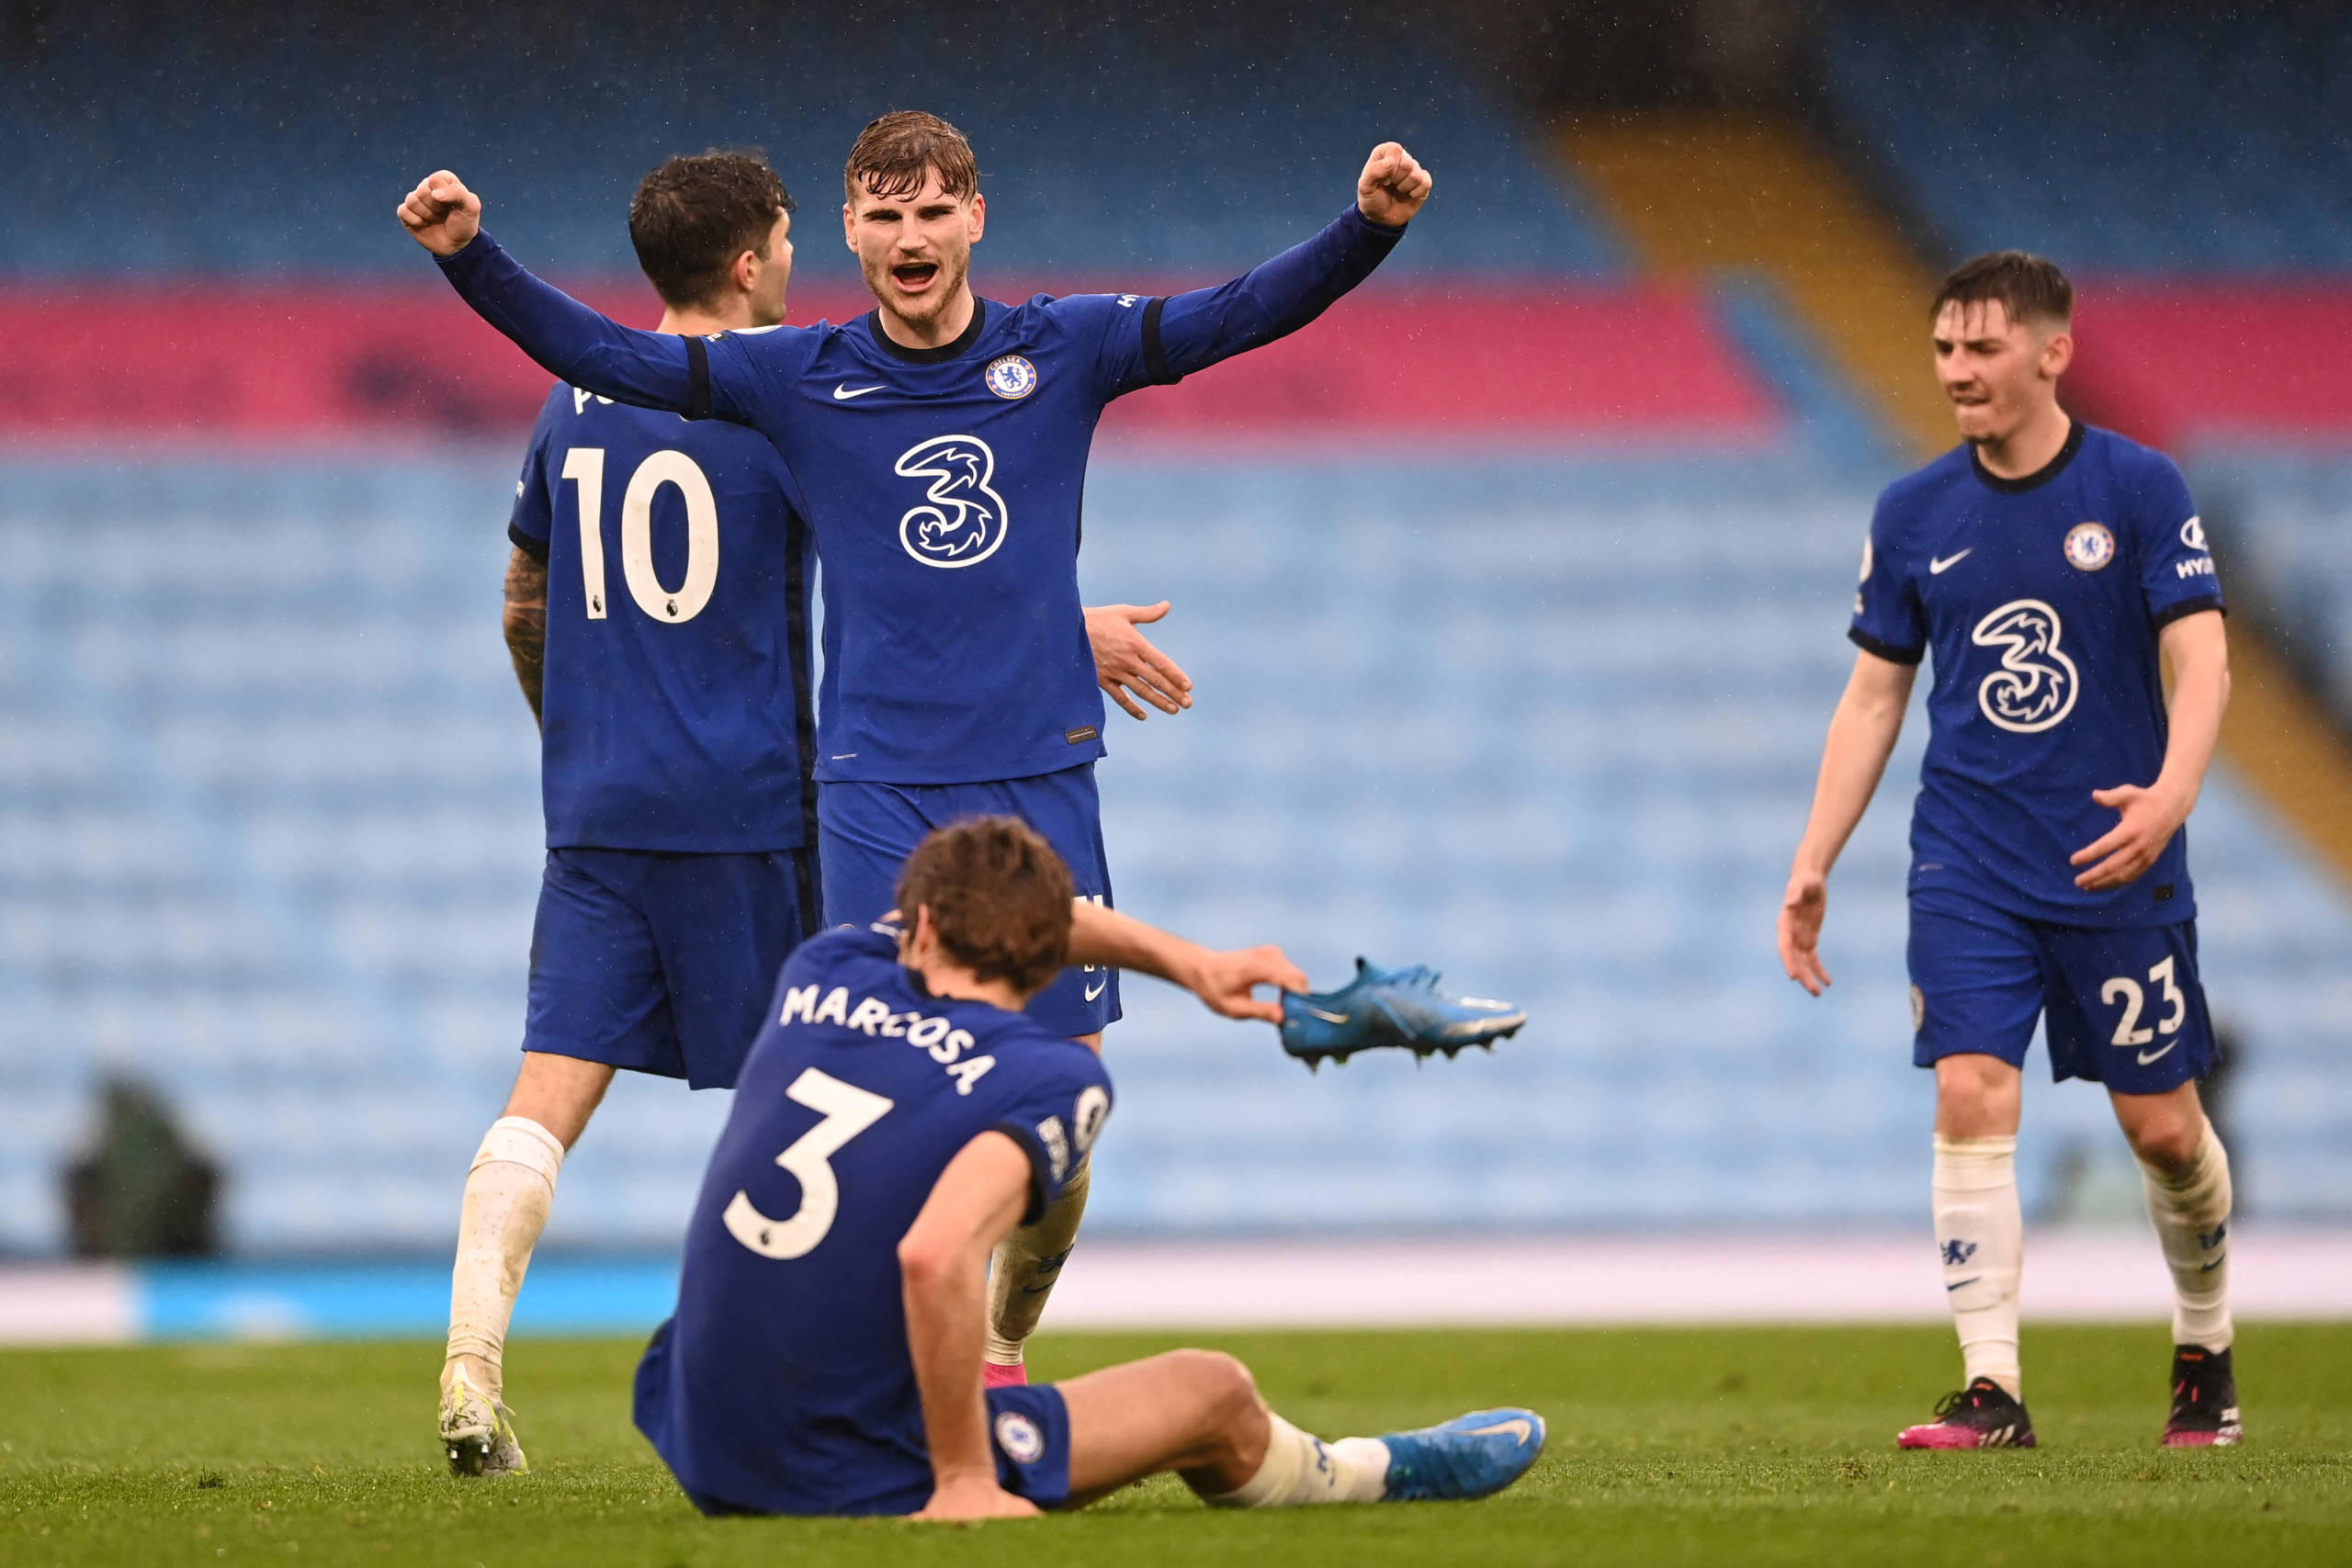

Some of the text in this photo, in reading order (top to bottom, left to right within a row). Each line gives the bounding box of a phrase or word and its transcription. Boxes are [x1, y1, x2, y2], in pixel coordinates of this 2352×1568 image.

[561, 447, 720, 624] 10
[894, 434, 1008, 569] 3
[1972, 599, 2079, 733] 3
[2101, 954, 2186, 1046] 23
[722, 1066, 895, 1261] 3
